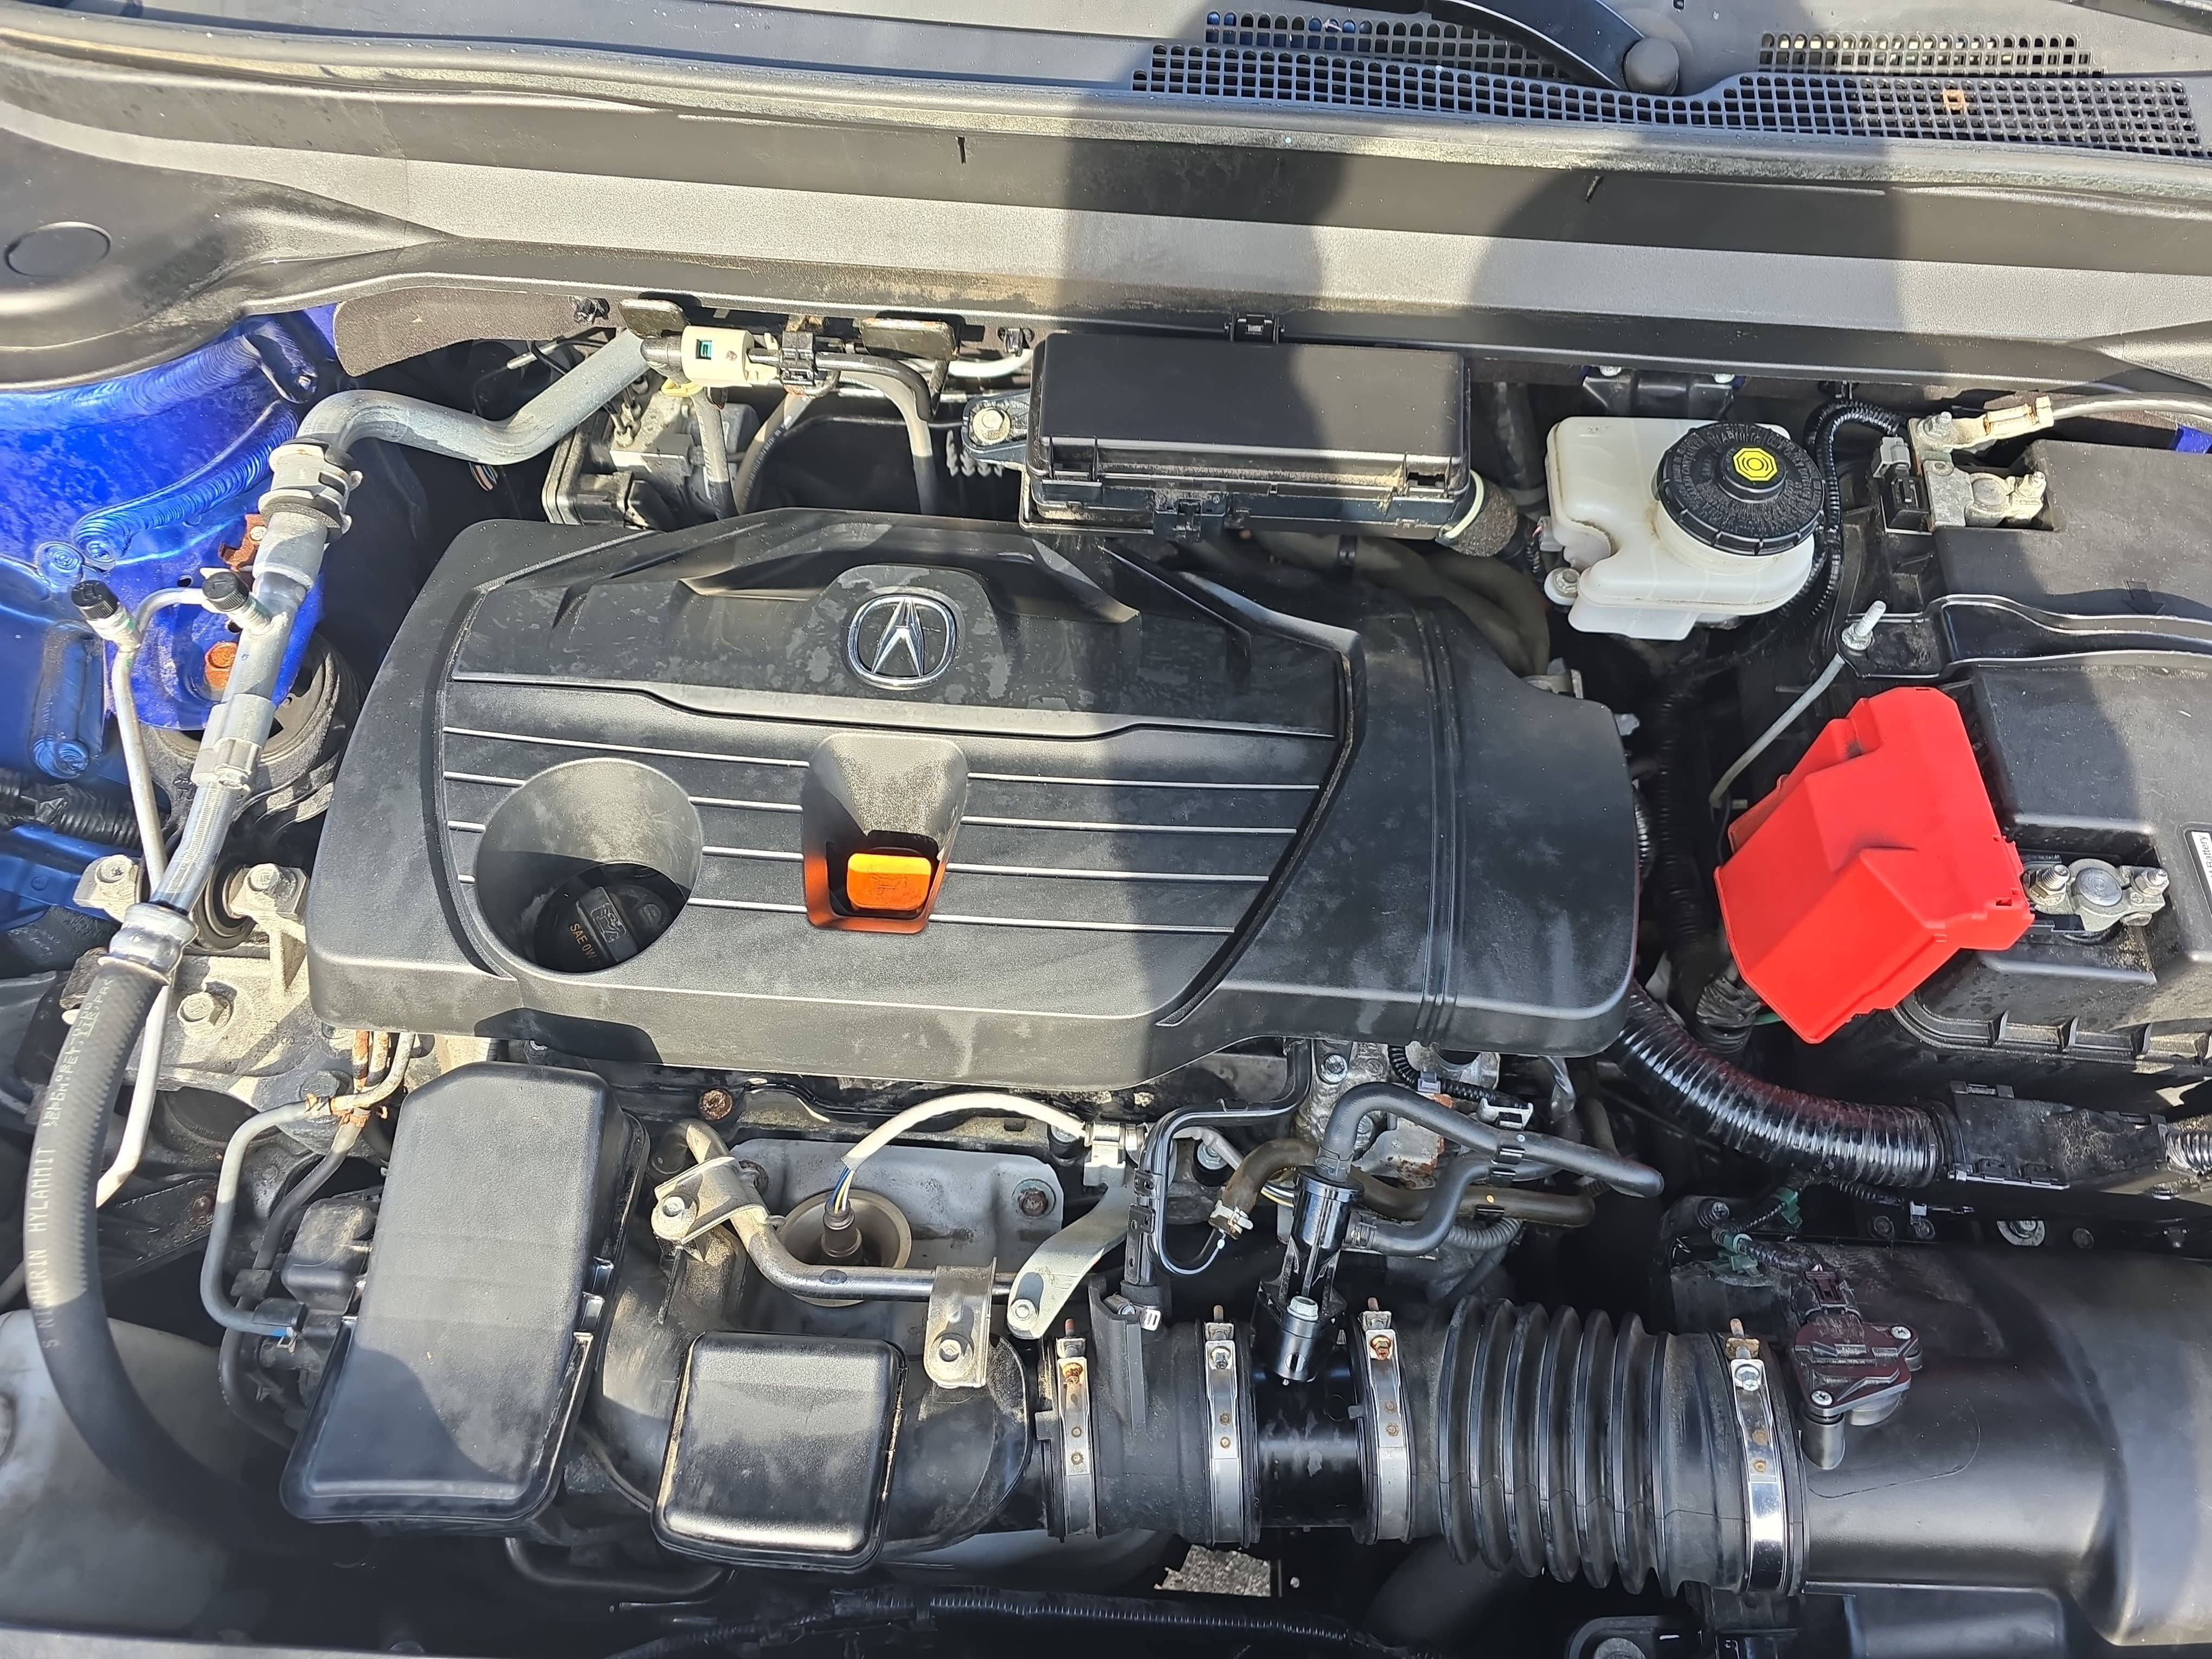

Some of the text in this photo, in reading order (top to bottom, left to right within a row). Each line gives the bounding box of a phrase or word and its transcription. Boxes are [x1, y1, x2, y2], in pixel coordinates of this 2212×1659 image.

[2198, 835, 2212, 867] Battery
[570, 923, 588, 944] SAE
[28, 1147, 56, 1233] HYLAMMIT
